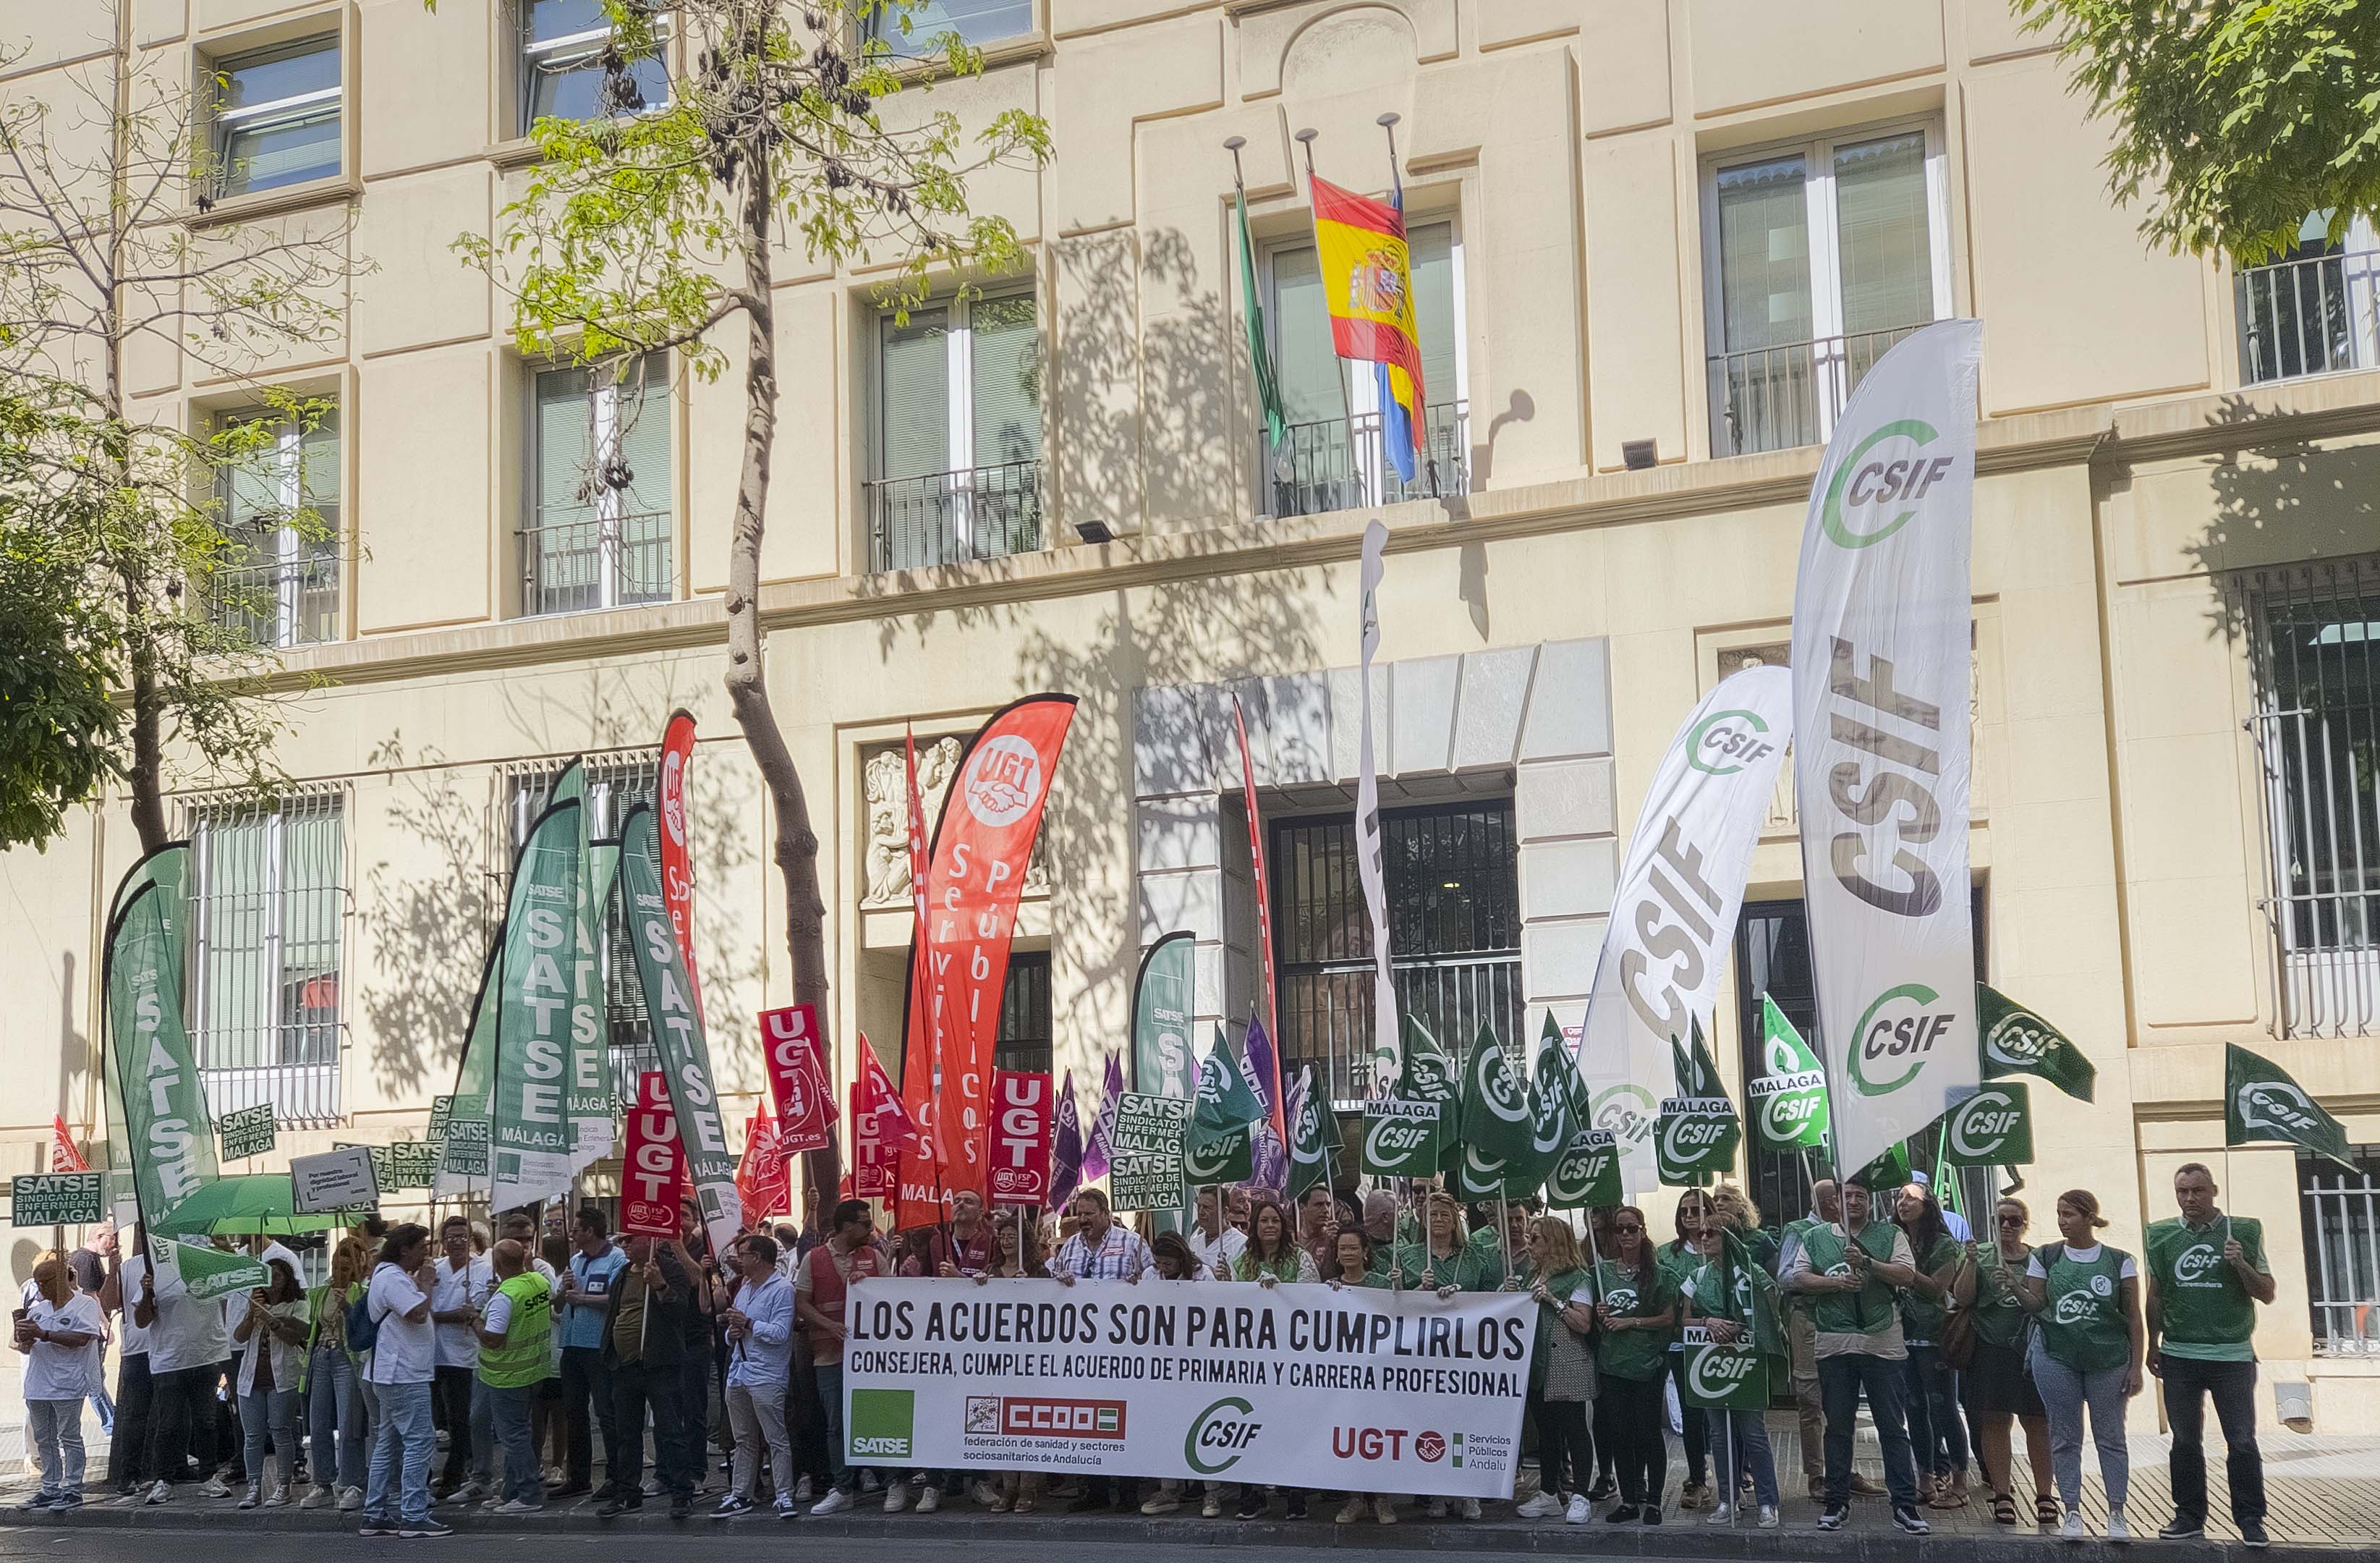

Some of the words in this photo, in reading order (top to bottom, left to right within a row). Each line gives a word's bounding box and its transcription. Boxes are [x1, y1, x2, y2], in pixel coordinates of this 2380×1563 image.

[1848, 456, 1955, 507] CSIF
[1704, 727, 1774, 764] CSIF
[978, 747, 1035, 792] UGT
[1829, 634, 1942, 918] CSIF
[1620, 816, 1722, 1043] CSIF
[521, 909, 569, 1123] SATSE
[645, 920, 726, 1153] SATSE
[1866, 1012, 1955, 1060] CSIF
[1998, 1025, 2065, 1056] CSIF
[136, 992, 200, 1199] SATSE
[1492, 1066, 1516, 1104] CS
[222, 1105, 272, 1132] SATSE
[1772, 1096, 1821, 1122] CSIF
[2251, 1091, 2318, 1129] CSIF
[224, 1124, 261, 1140] SINDICATO
[263, 1122, 273, 1130] DE
[450, 1122, 488, 1141] SATSE
[1002, 1077, 1041, 1167] UGT
[1118, 1114, 1176, 1131] SINDICATO
[1965, 1111, 2021, 1134] CSIF
[224, 1130, 273, 1148] ENFERMERIA
[501, 1125, 566, 1147] MÁLAGA
[858, 1113, 880, 1164] GT
[1378, 1127, 1429, 1149] CSIF
[1676, 1123, 1727, 1145] CSIF
[224, 1138, 273, 1161] MALAGA
[394, 1143, 443, 1159] SATS
[634, 1114, 677, 1202] UGT
[449, 1159, 487, 1175] MALAGA
[1112, 1156, 1180, 1177] SATSE
[1166, 1174, 1180, 1182] DE
[1560, 1156, 1610, 1181] CSIF
[16, 1174, 99, 1195] SATSE
[901, 1183, 954, 1206] MALA
[16, 1193, 80, 1203] SINDICATO
[16, 1200, 98, 1212] ENFERMERIA
[1115, 1193, 1181, 1211] MALAGA
[16, 1208, 97, 1225] MALAGA
[189, 1266, 263, 1295] SATSE
[854, 1301, 914, 1341] LOS
[925, 1302, 1099, 1344] ACUERDOS
[1108, 1303, 1176, 1347] SON
[1186, 1305, 1278, 1350] PARA
[1290, 1309, 1525, 1361] CUMPLIRLOS
[851, 1350, 957, 1378] CONSEJERA,
[963, 1352, 1035, 1377] CUMPLE
[1040, 1354, 1058, 1377] EL
[1063, 1355, 1144, 1380] ACUERDO
[1150, 1357, 1173, 1381] DE
[1178, 1358, 1267, 1385] PRIMARIA
[1273, 1361, 1285, 1386] Y
[1290, 1363, 1376, 1390] CARRERA
[1382, 1367, 1522, 1397] PROFESIONAL
[1703, 1355, 1756, 1378] CSIF
[1009, 1404, 1095, 1431] CCOO
[853, 1437, 908, 1454] SATSE
[964, 1436, 1017, 1448] federación
[1020, 1438, 1032, 1448] de
[1034, 1439, 1069, 1450] sanidad
[1071, 1443, 1078, 1452] y
[1079, 1441, 1126, 1452] sectores
[1201, 1420, 1262, 1449] CSIF
[1333, 1426, 1408, 1461] UGT
[1469, 1433, 1511, 1445] Servicios
[963, 1451, 1040, 1462] sociosanitarios
[1041, 1452, 1052, 1462] de
[1053, 1453, 1102, 1465] Andalucía
[1469, 1446, 1508, 1457] Públicos
